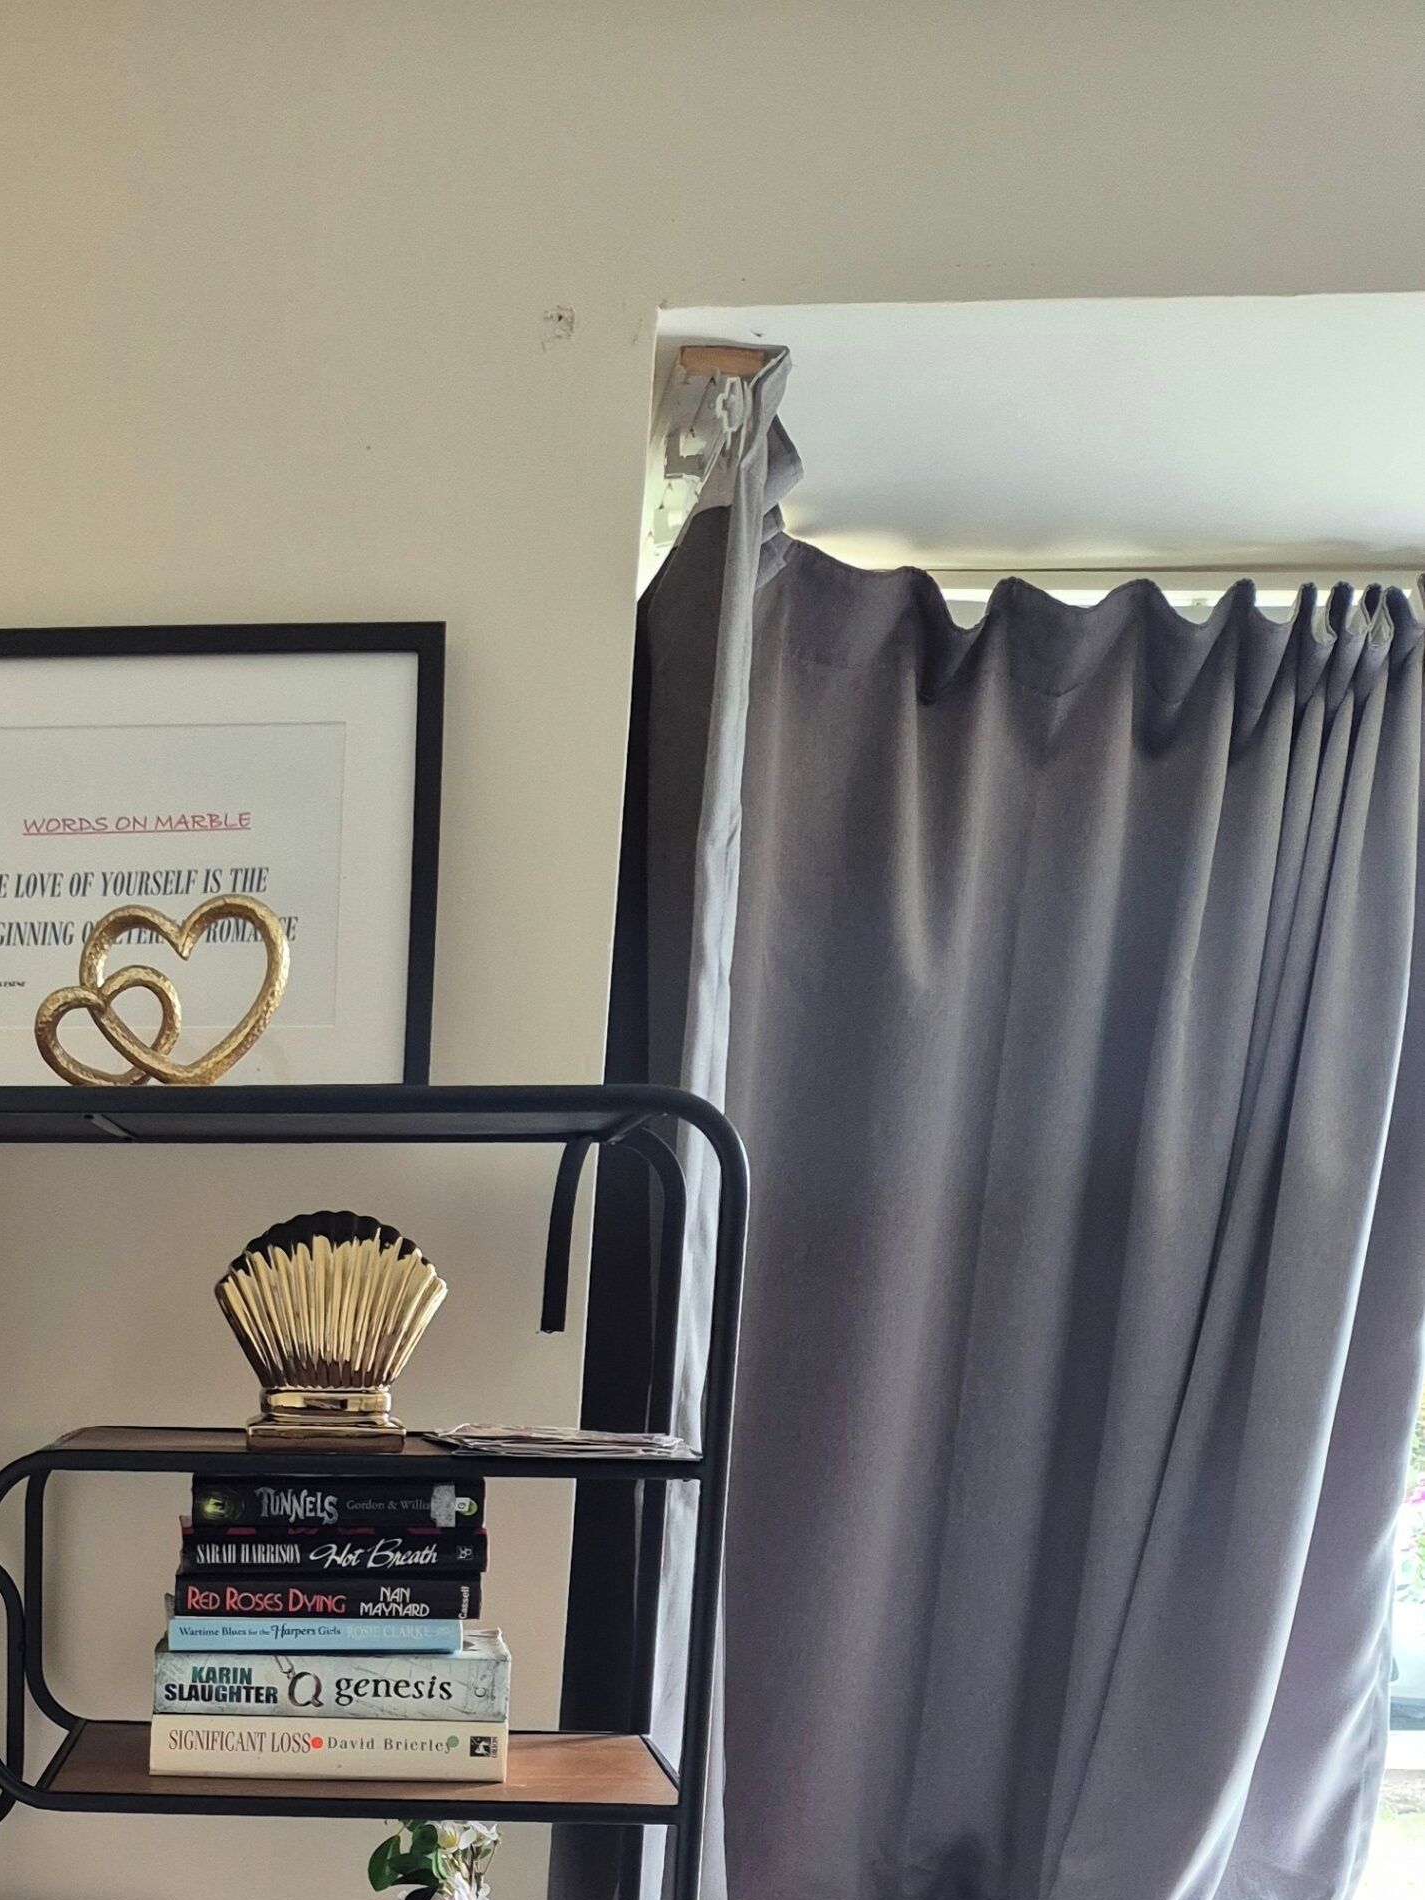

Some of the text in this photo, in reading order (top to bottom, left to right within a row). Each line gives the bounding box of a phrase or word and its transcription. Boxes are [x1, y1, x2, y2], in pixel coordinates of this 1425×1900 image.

[23, 811, 251, 833] WORDS ON MARBLE
[14, 872, 64, 899] LOVE
[69, 871, 95, 897] OF
[101, 868, 198, 897] YOURSELF
[203, 868, 223, 894] IS
[229, 866, 270, 893] THE
[255, 1486, 339, 1525] TUNNELS
[345, 1499, 385, 1510] Gordon
[387, 1499, 397, 1510] &
[196, 1538, 438, 1569] SARAH HARRISON Hot Breath
[187, 1585, 347, 1613] RED ROSES DYING
[380, 1586, 410, 1603] NAN
[458, 1586, 470, 1619] Cassell
[360, 1602, 430, 1617] MAYNARD
[179, 1626, 219, 1636] Wartime
[221, 1626, 247, 1636] Blues
[270, 1623, 316, 1639] Harpers
[318, 1626, 342, 1636] Girls
[346, 1625, 433, 1640] ROSIE CLARKE
[191, 1666, 253, 1685] KARIN
[164, 1684, 278, 1704] SLAUGHTER
[334, 1675, 453, 1706] genesis
[168, 1729, 452, 1754] SIGNIFICANT LOSS David Brierley
